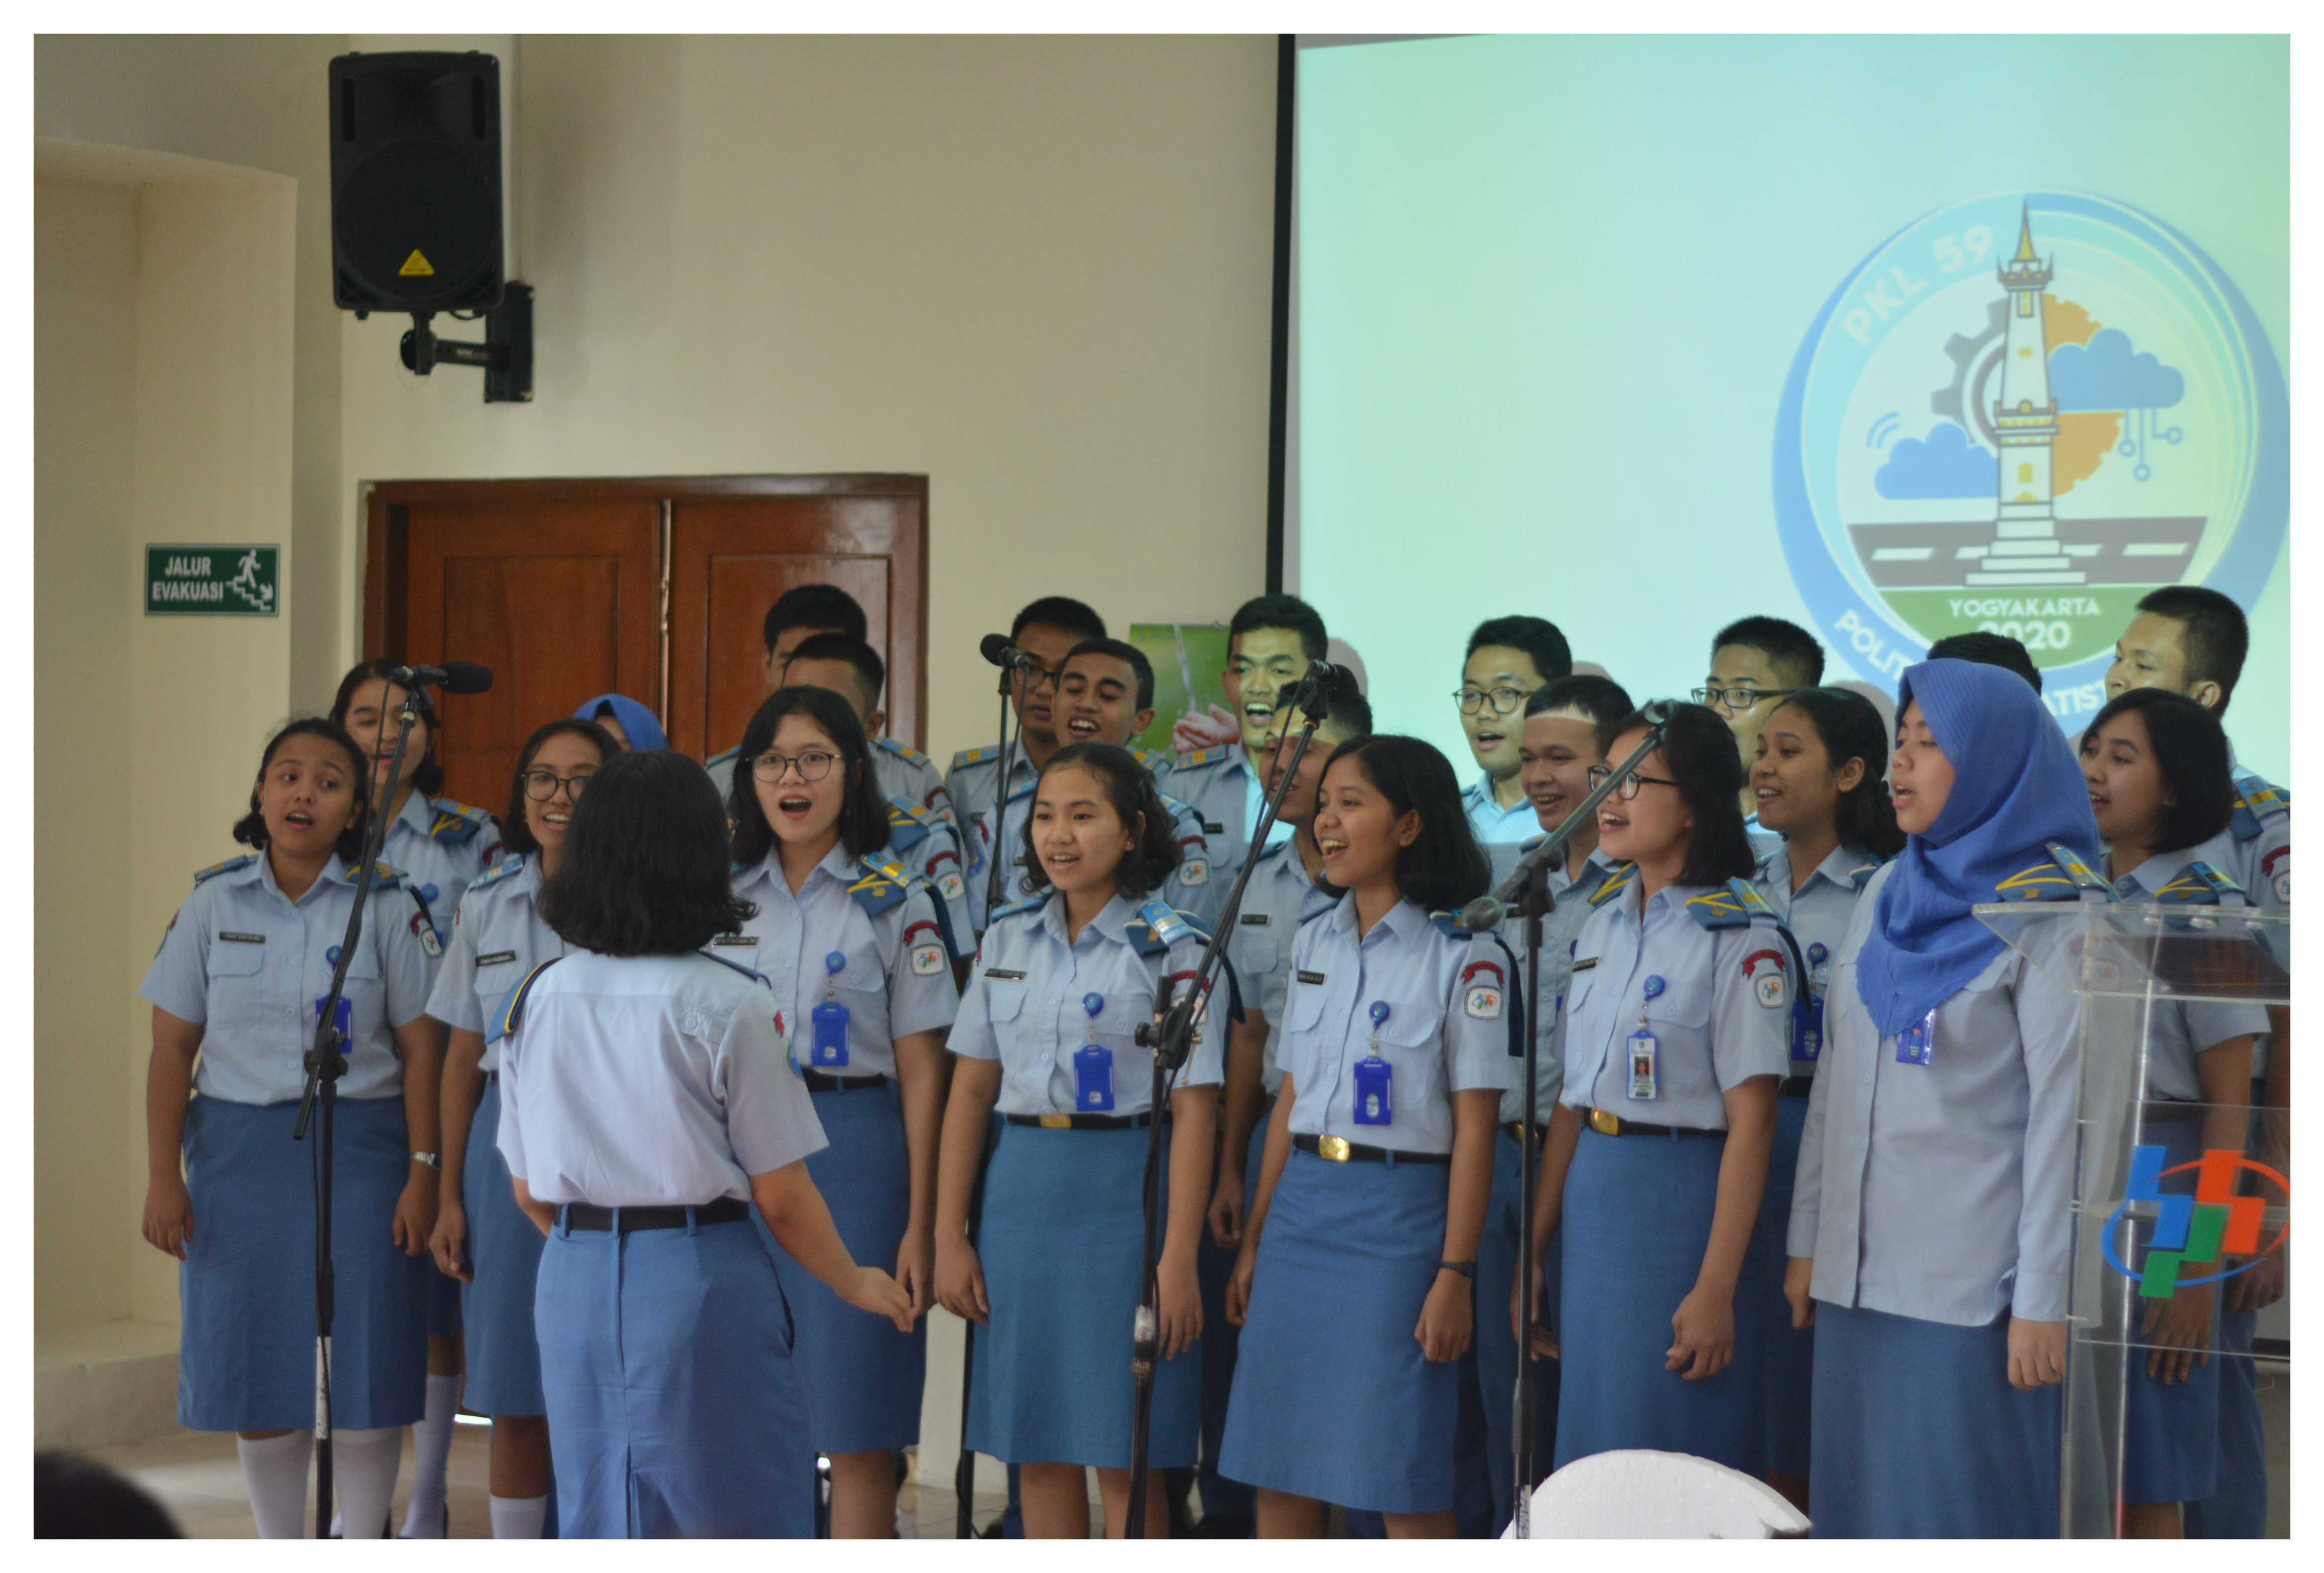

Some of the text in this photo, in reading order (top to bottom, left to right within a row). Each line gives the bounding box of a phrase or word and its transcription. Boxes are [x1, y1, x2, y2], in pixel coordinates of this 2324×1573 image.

[1842, 224, 1992, 346] PKL 59
[165, 556, 211, 577] JALUR
[152, 581, 224, 601] EVAKUASI
[1948, 597, 2100, 617] YOGYAKARTA
